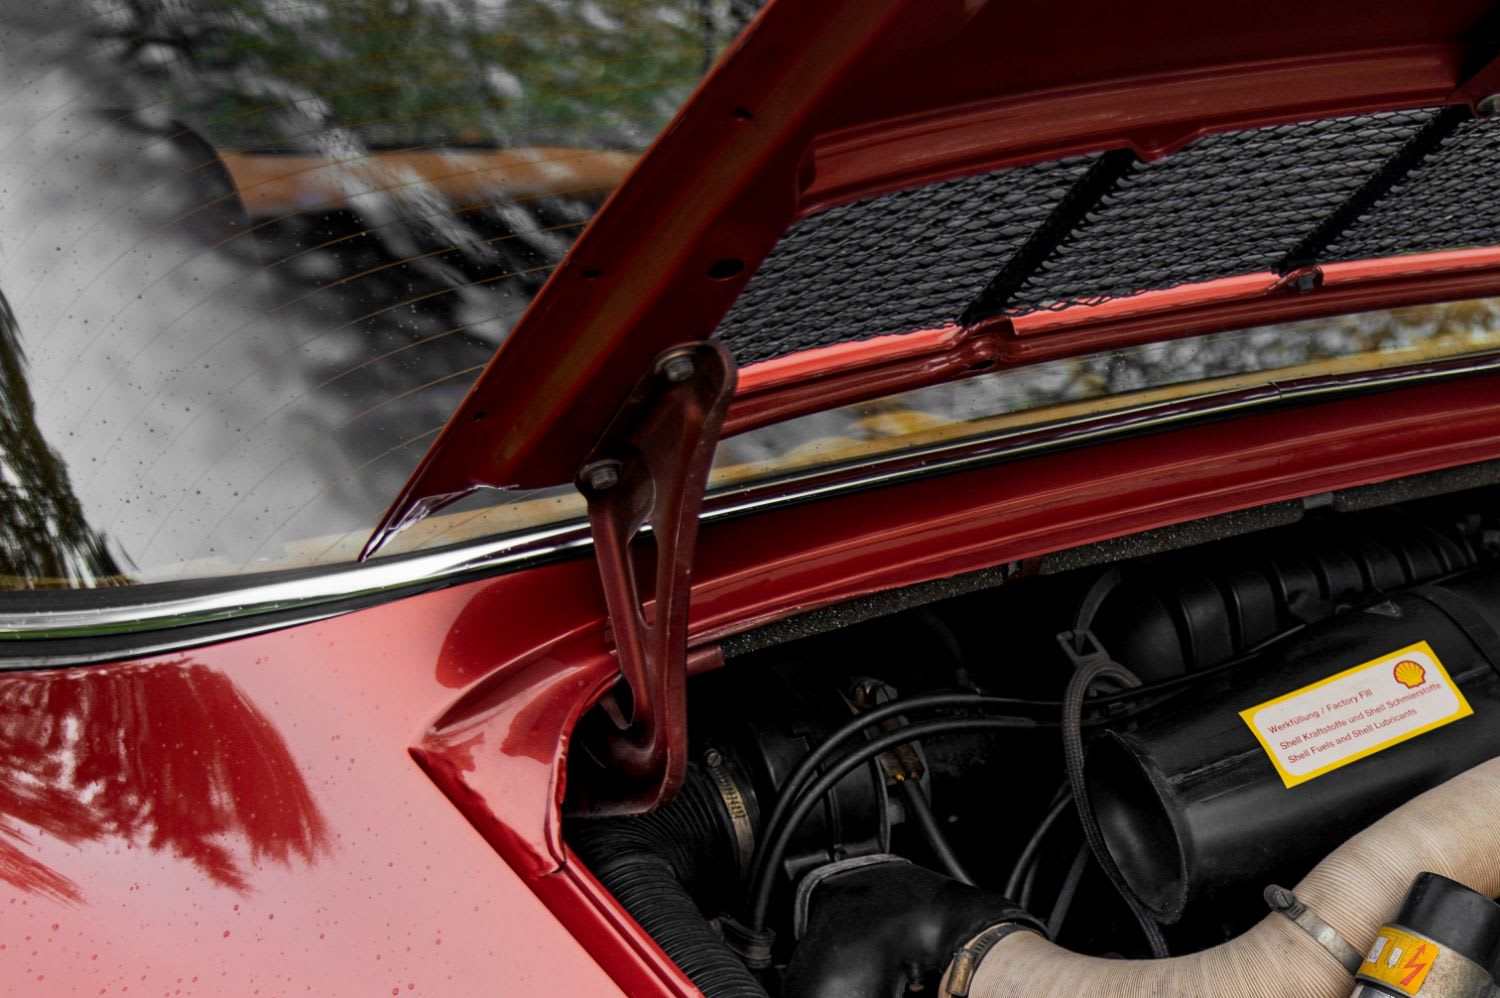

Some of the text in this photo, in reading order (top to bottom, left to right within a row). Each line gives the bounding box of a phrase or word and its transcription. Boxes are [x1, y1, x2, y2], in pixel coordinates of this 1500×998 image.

[1280, 683, 1442, 750] Shell Kraftstoffe und Shell Schmierstoffe
[1326, 694, 1358, 712] Factory
[1358, 688, 1373, 699] Fill
[1288, 708, 1418, 764] Shell Fuels and Shell Lubricants
